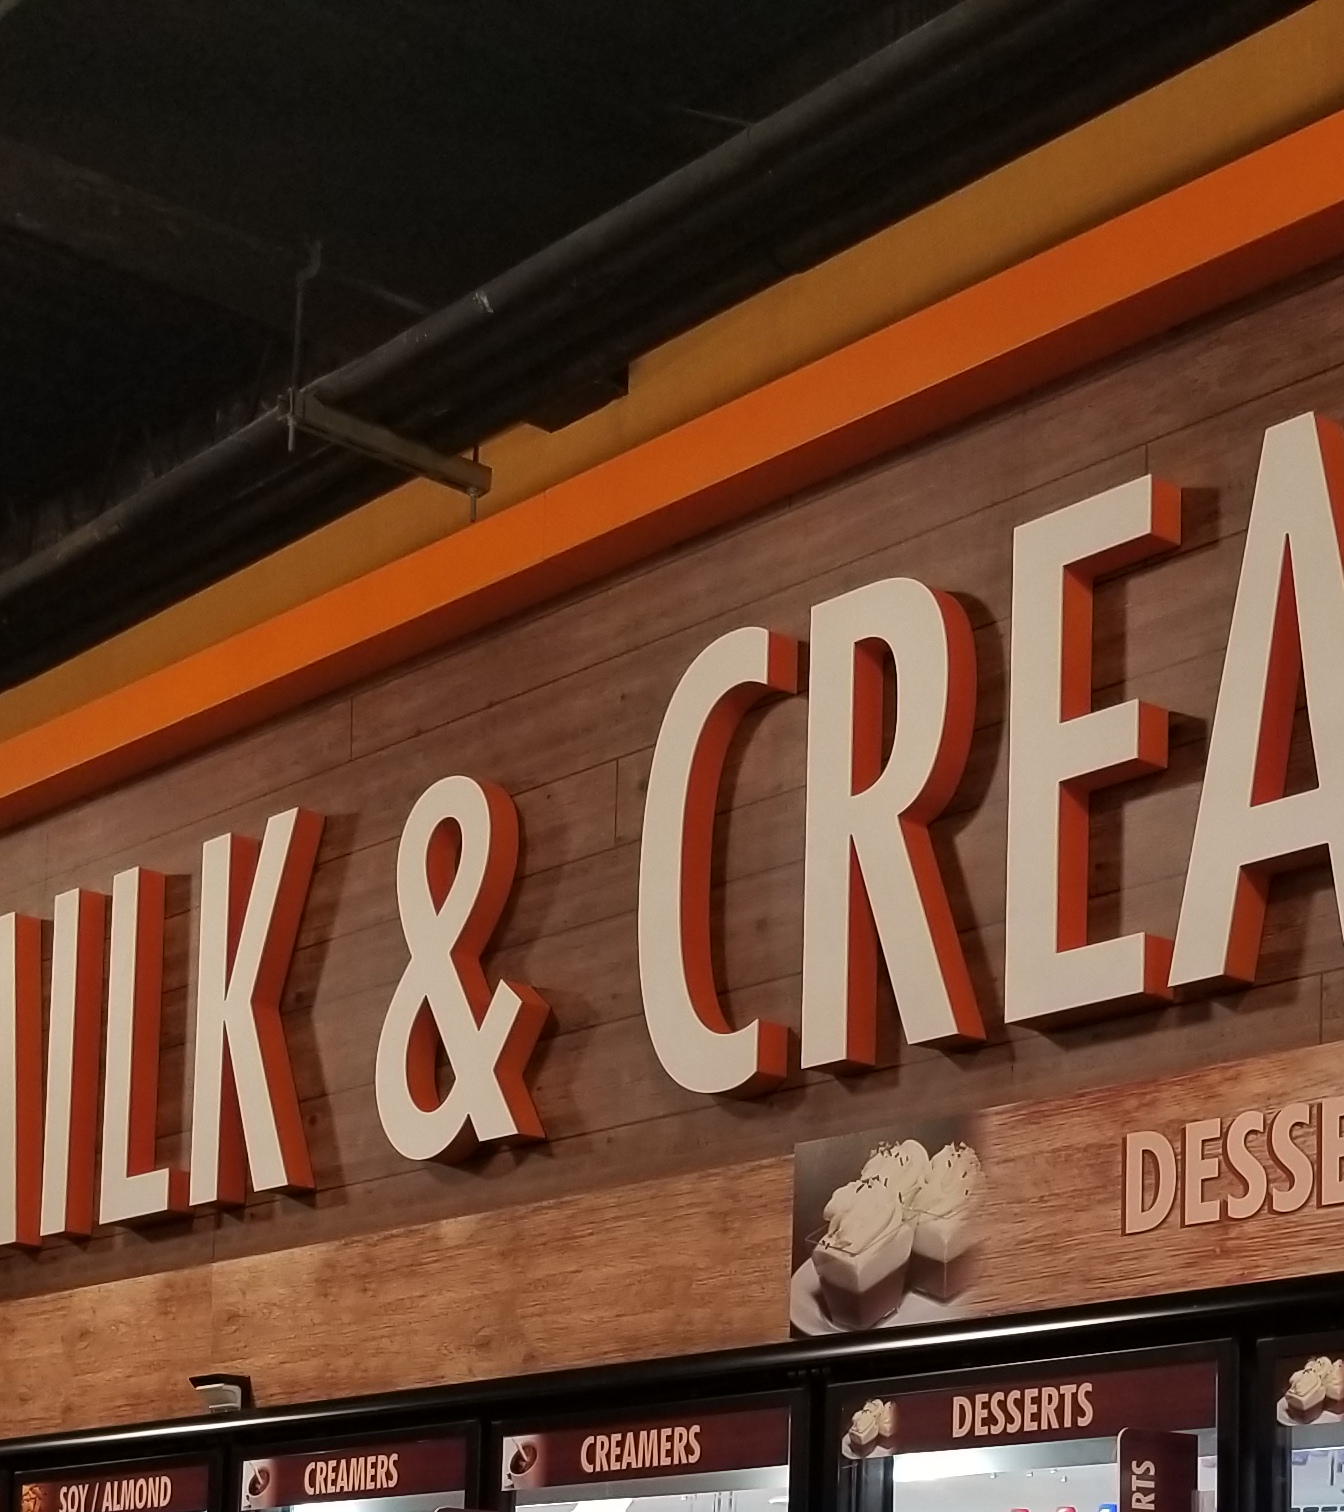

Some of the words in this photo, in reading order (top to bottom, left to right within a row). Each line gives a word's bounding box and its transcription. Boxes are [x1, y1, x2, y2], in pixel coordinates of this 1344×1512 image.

[374, 774, 548, 1165] &
[952, 1382, 1094, 1438] DESSERTS
[581, 1425, 701, 1473] CREAMERS
[101, 1476, 172, 1512] ALMOND
[304, 1453, 398, 1496] CREAMERS
